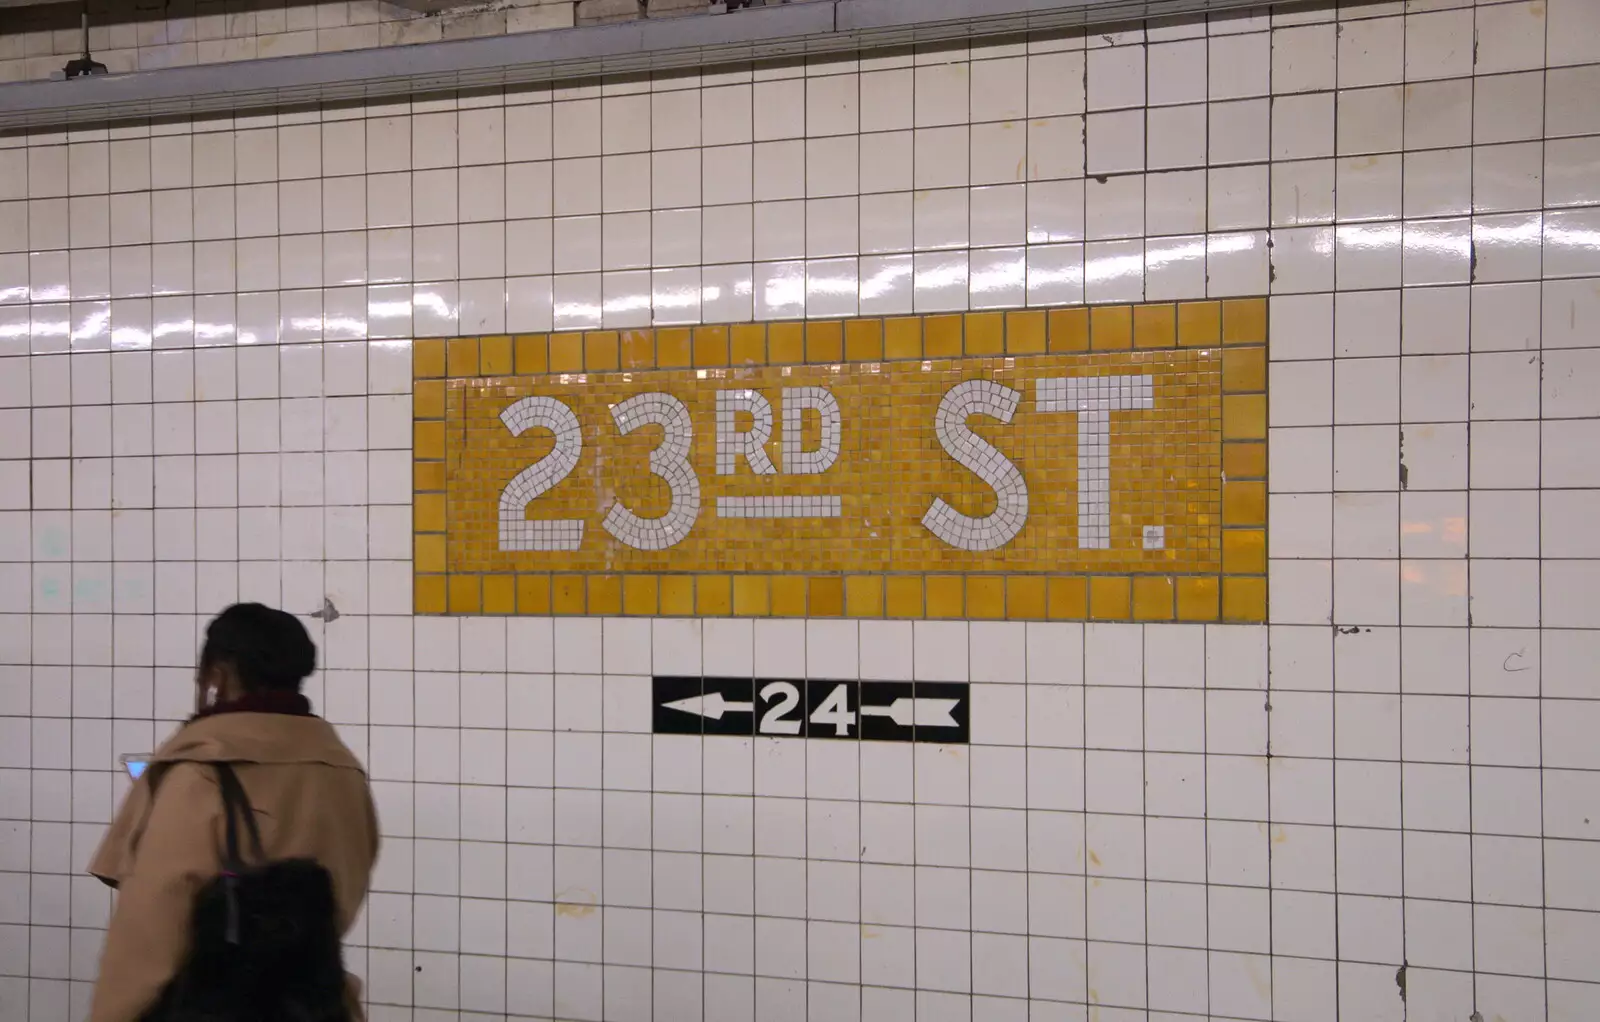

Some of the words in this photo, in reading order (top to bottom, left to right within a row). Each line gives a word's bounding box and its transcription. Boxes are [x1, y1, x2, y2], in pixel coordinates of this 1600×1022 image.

[499, 387, 841, 550] 23RD
[922, 375, 1164, 551] ST.
[759, 682, 856, 736] 24
